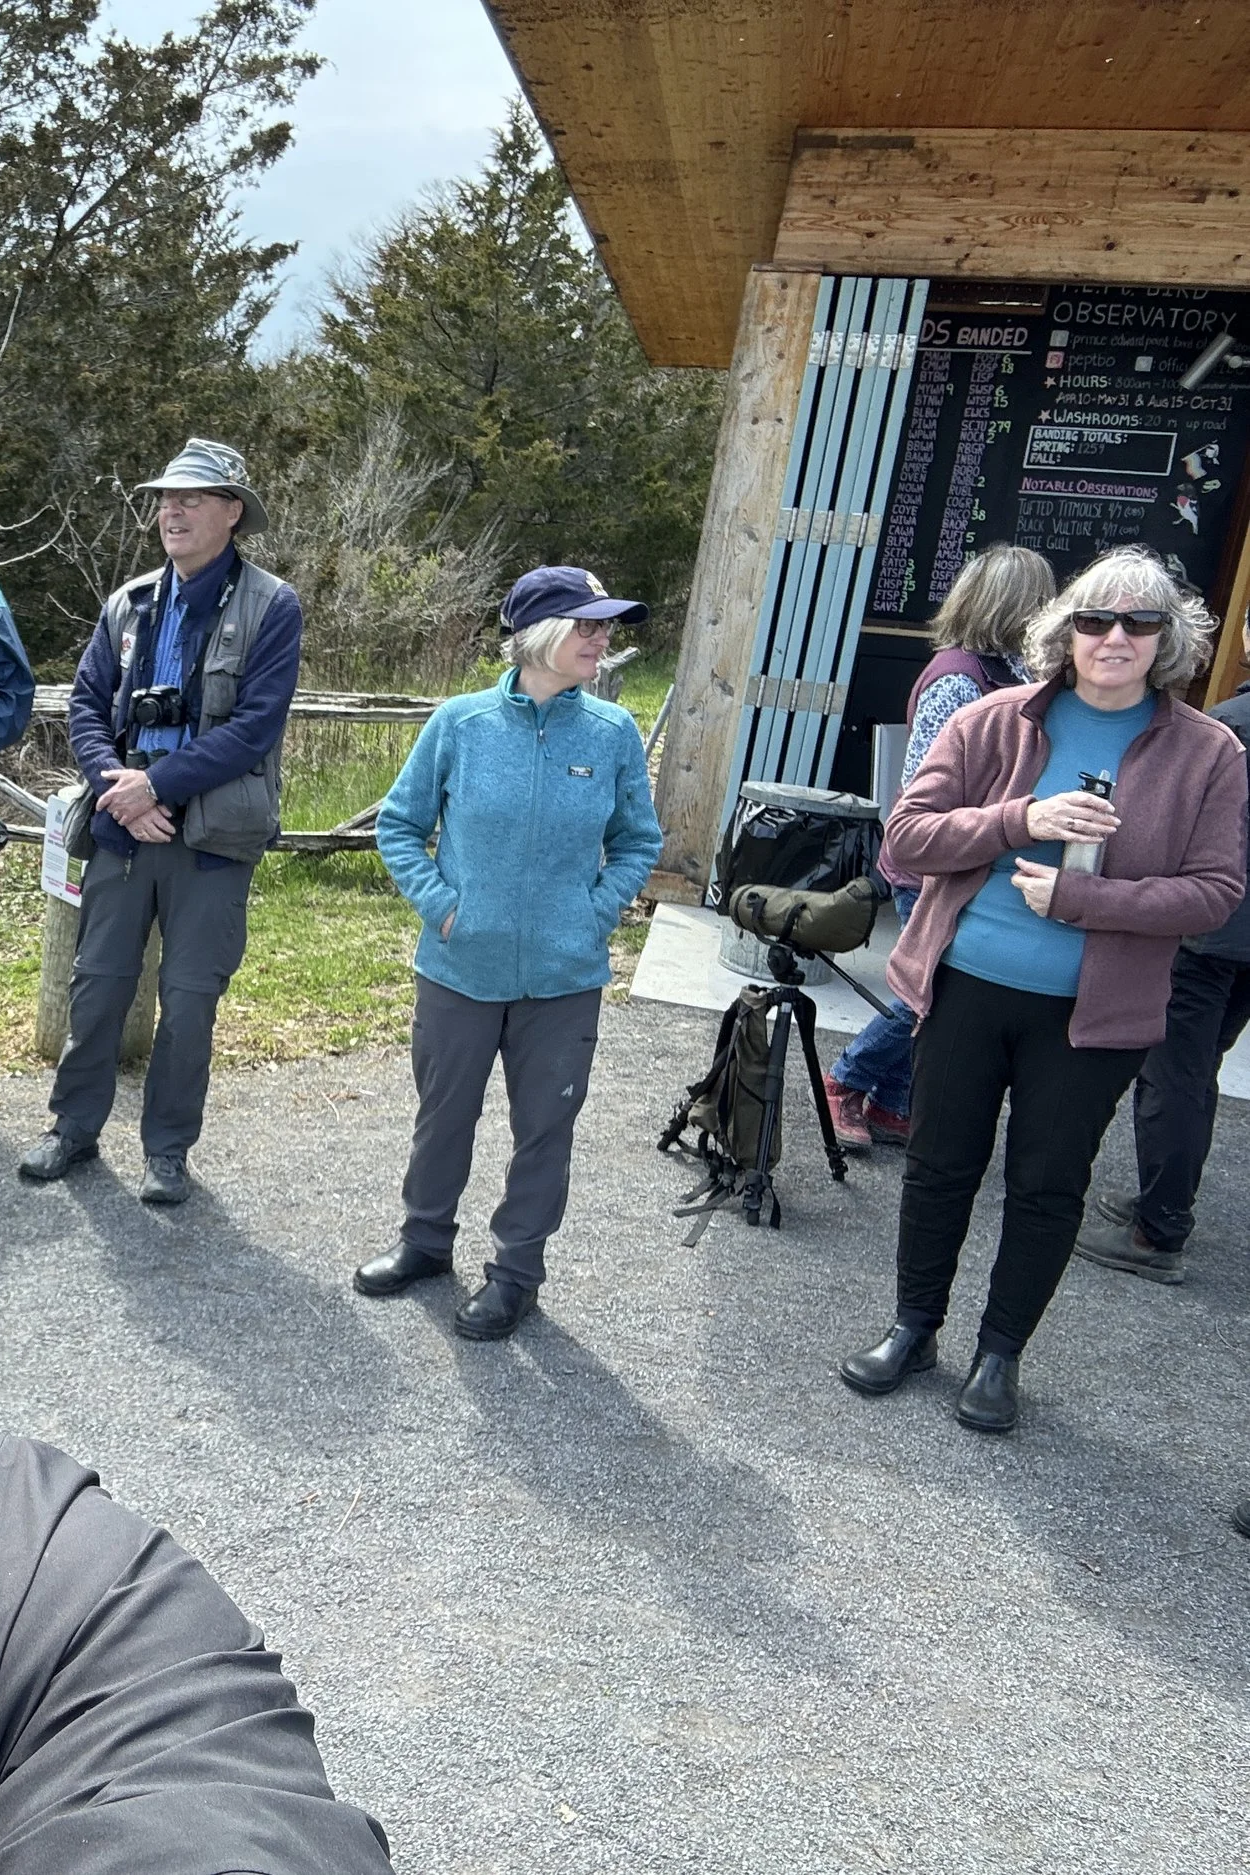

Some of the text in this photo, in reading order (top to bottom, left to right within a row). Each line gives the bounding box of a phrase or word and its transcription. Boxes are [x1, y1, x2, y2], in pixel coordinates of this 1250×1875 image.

[1053, 301, 1237, 333] OBSERVATORY
[957, 327, 1029, 347] BANDED
[1002, 353, 1012, 364] 6
[1001, 362, 1015, 374] 18
[1059, 376, 1112, 389] HOURS:
[946, 383, 954, 396] 9
[995, 384, 1005, 397] 6
[993, 396, 1009, 408] 15
[1135, 394, 1145, 406] &
[1053, 409, 1143, 427] WASHROOMS:
[988, 420, 1012, 434] 279
[960, 431, 995, 444] NOCA 2
[1034, 429, 1128, 444] BANDING TOTALS:
[1032, 440, 1075, 454] SPRING:
[1030, 453, 1062, 465] FALL:
[900, 472, 928, 483] OVEN
[977, 476, 986, 488] 2
[1022, 477, 1159, 499] NOTABLE OBSERVATIONS
[946, 496, 980, 510] COGR 1
[1018, 498, 1054, 517] TUFTED
[1058, 500, 1103, 518] TITMOUSE
[892, 504, 919, 516] COYE
[944, 508, 986, 521] BHCO 38
[888, 525, 915, 537] CAWA
[942, 520, 968, 531] BAOR
[1016, 516, 1045, 532] BLACK
[1052, 518, 1093, 536] VULTURE
[885, 536, 913, 548] BLPW
[965, 531, 976, 543] 5
[1014, 533, 1043, 549] LITTLE
[1046, 535, 1070, 551] GULL
[883, 547, 908, 558] SCTA
[935, 550, 963, 561] AMGO
[881, 558, 915, 570] EATO 3
[933, 559, 962, 571] HOSP
[879, 568, 913, 581] ATSP 5
[877, 578, 916, 592] CHSP 15
[929, 581, 951, 592] EAK
[900, 590, 908, 602] 3
[872, 600, 898, 612] SAVS
